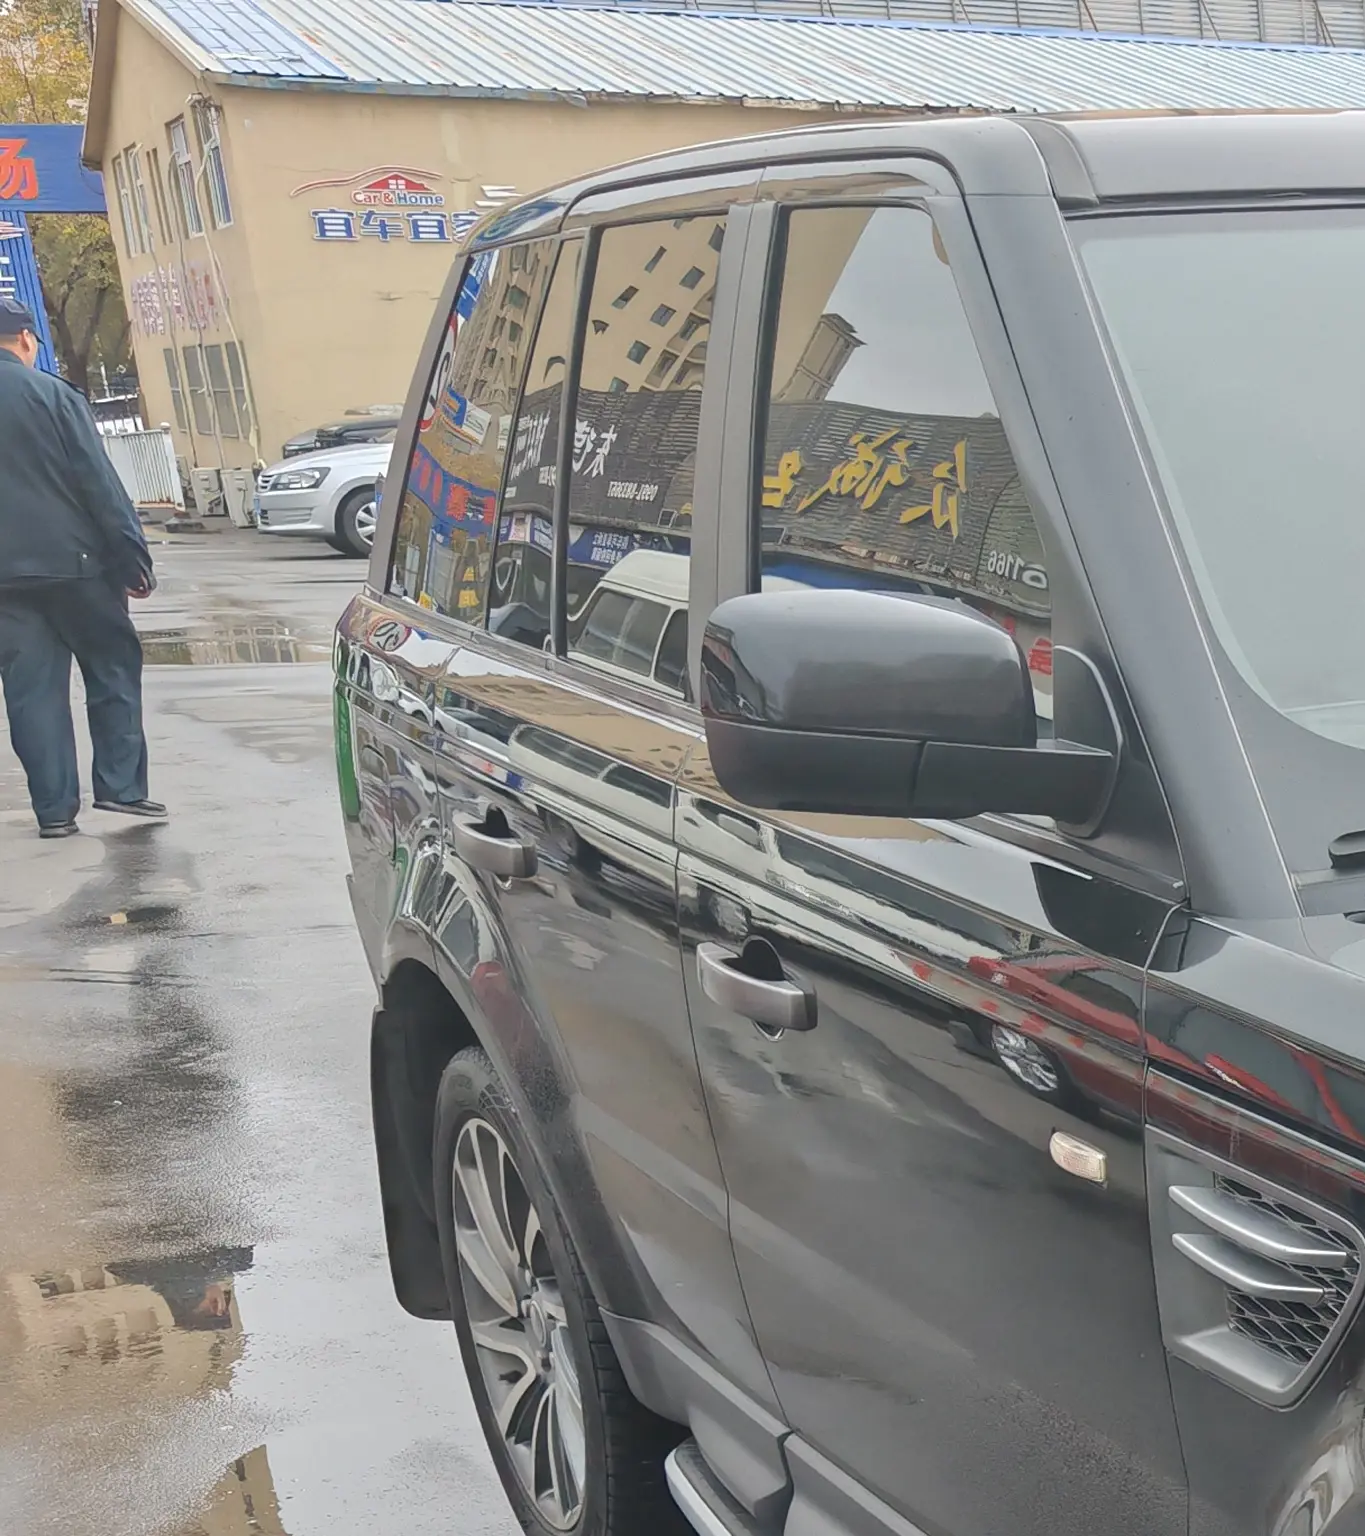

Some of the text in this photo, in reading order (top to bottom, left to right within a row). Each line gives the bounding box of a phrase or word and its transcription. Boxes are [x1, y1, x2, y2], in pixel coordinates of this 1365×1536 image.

[352, 191, 444, 206] Car & Home
